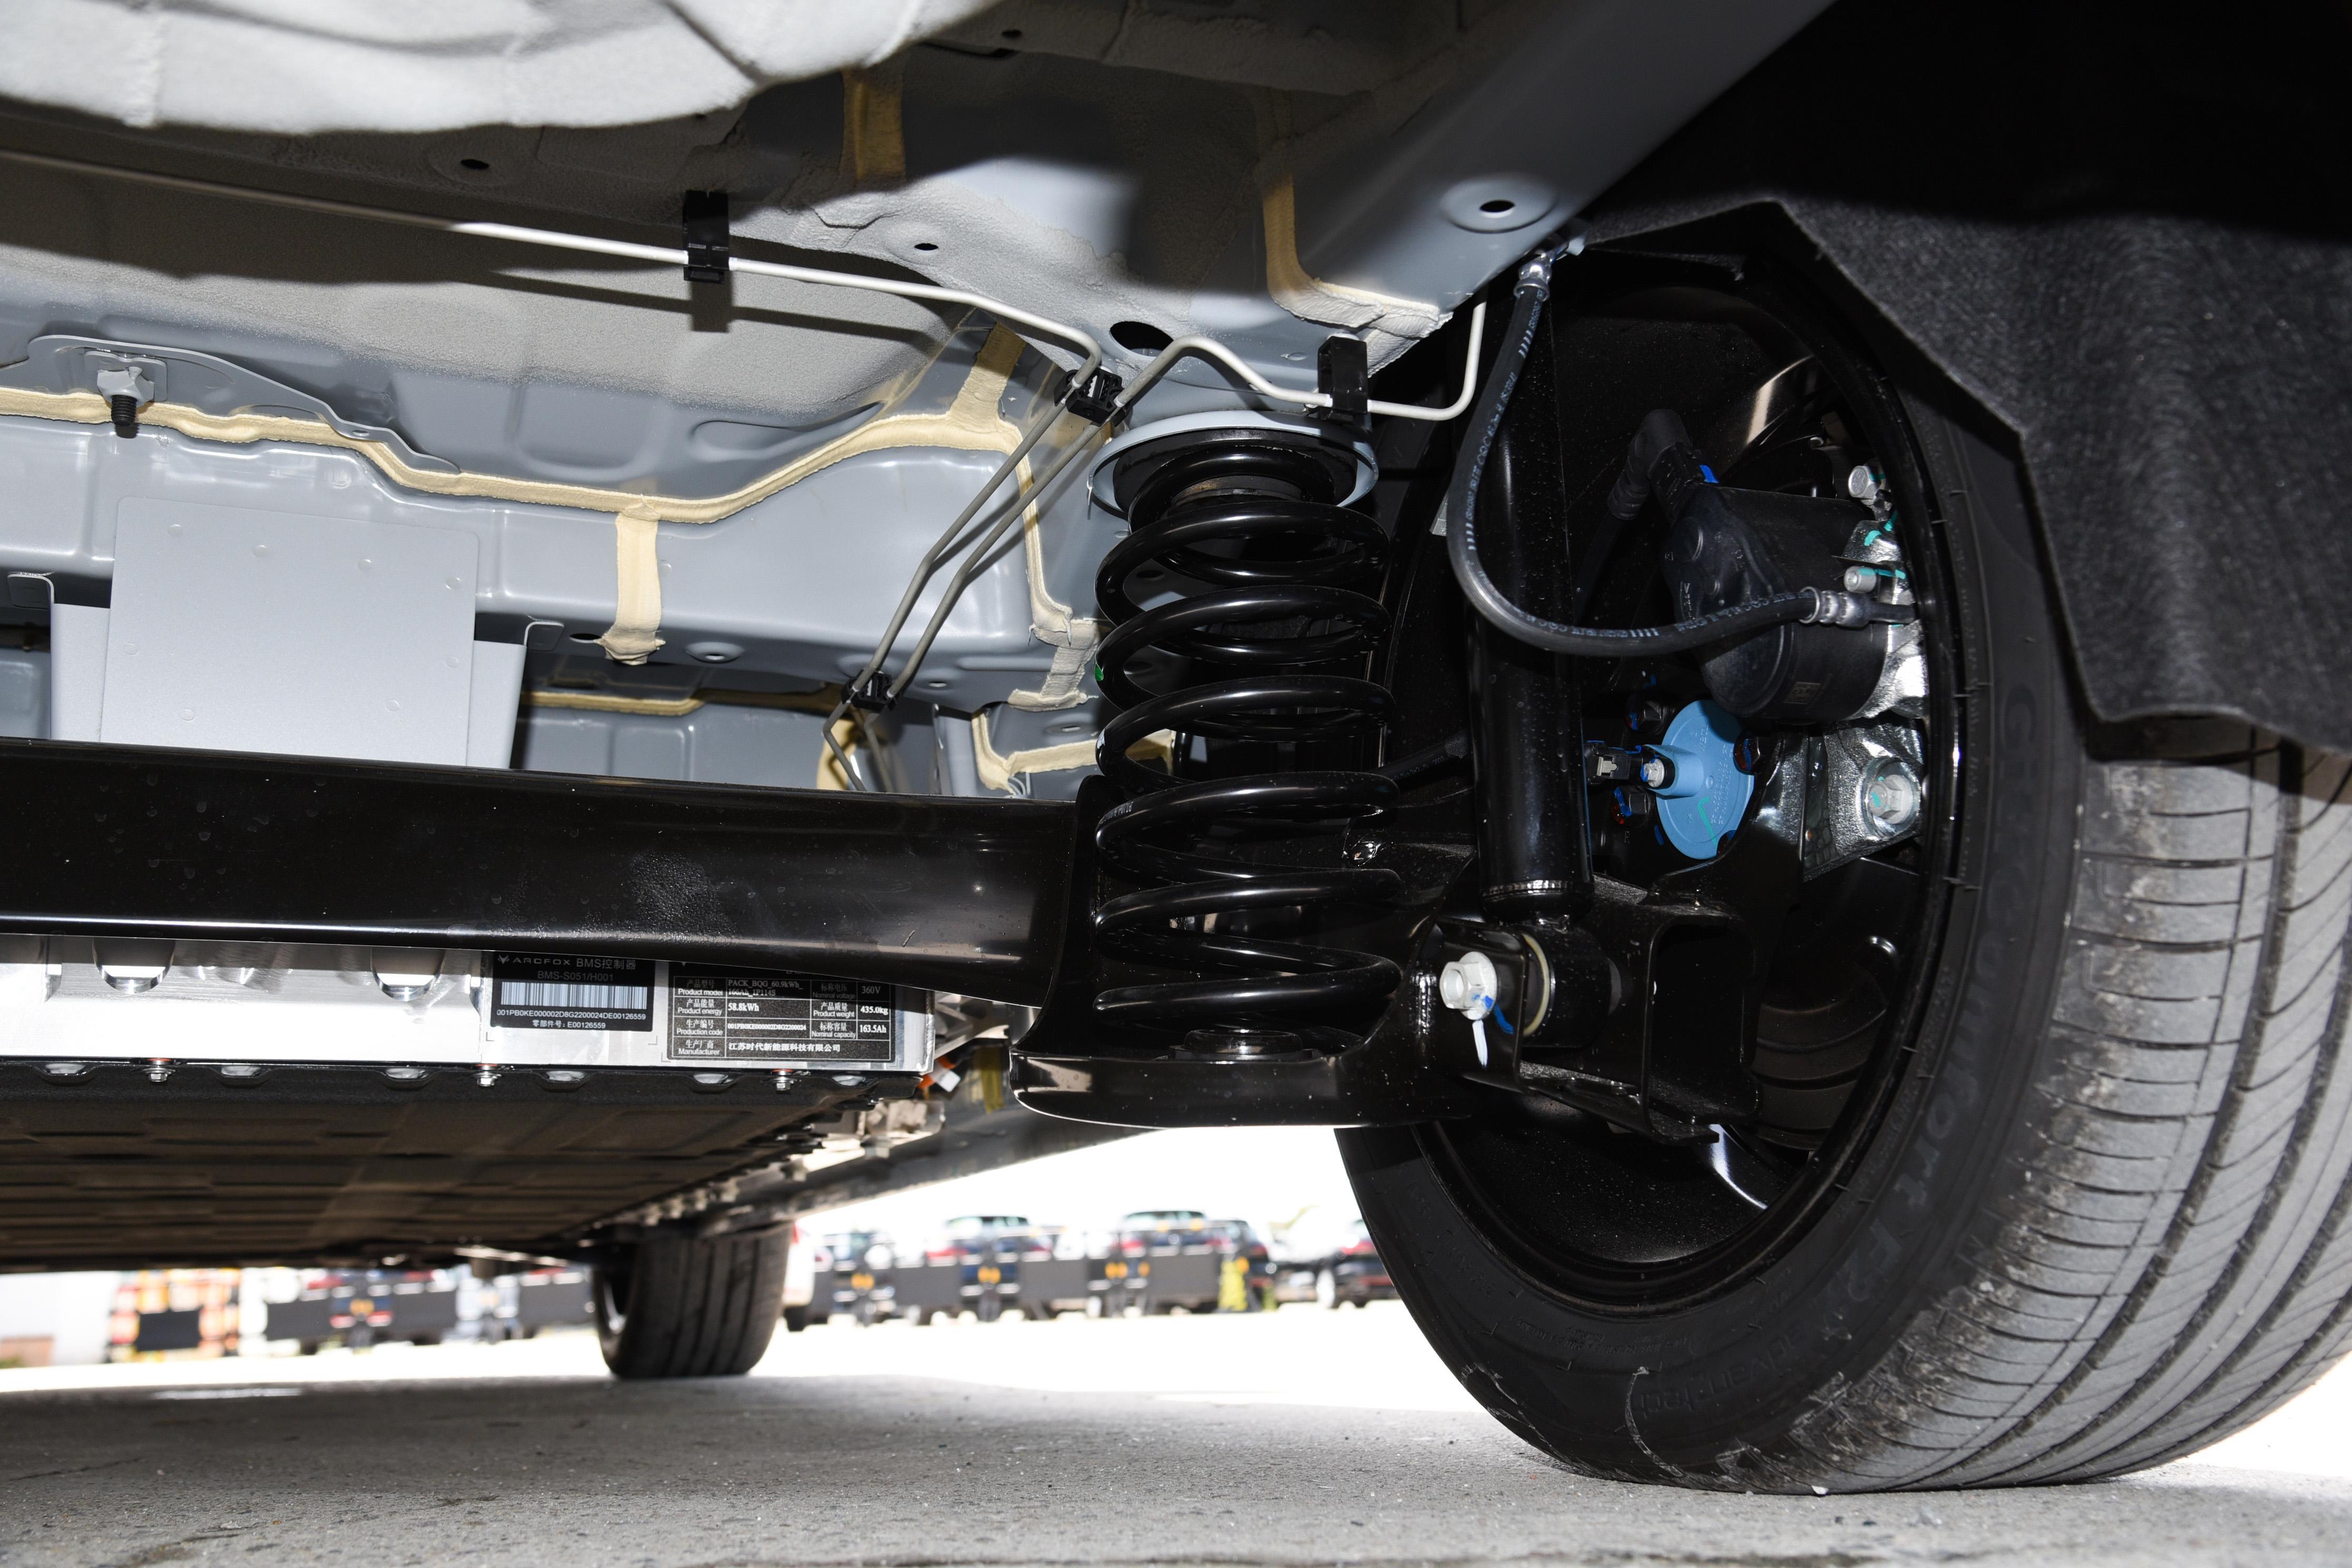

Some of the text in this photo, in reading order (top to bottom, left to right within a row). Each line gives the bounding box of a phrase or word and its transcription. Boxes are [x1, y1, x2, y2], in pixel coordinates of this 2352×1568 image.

[513, 957, 571, 965] ARCFOX
[537, 971, 613, 982] BMS-S051/H001
[687, 979, 715, 989] 产品型号
[821, 983, 848, 992] 标称电压
[861, 986, 881, 994] 360V
[687, 998, 715, 1008] 产品能量
[728, 1003, 759, 1012] 58.8kWh
[821, 1002, 848, 1011] 产品质量
[860, 1006, 889, 1015] 435.0kg
[686, 1019, 714, 1028] 生产编号
[820, 1022, 847, 1031] 标称容量
[859, 1024, 887, 1033] 163.5Ah
[685, 1039, 713, 1049] 生产厂商
[728, 1042, 840, 1052] 江苏时代新能源科技有限公司
